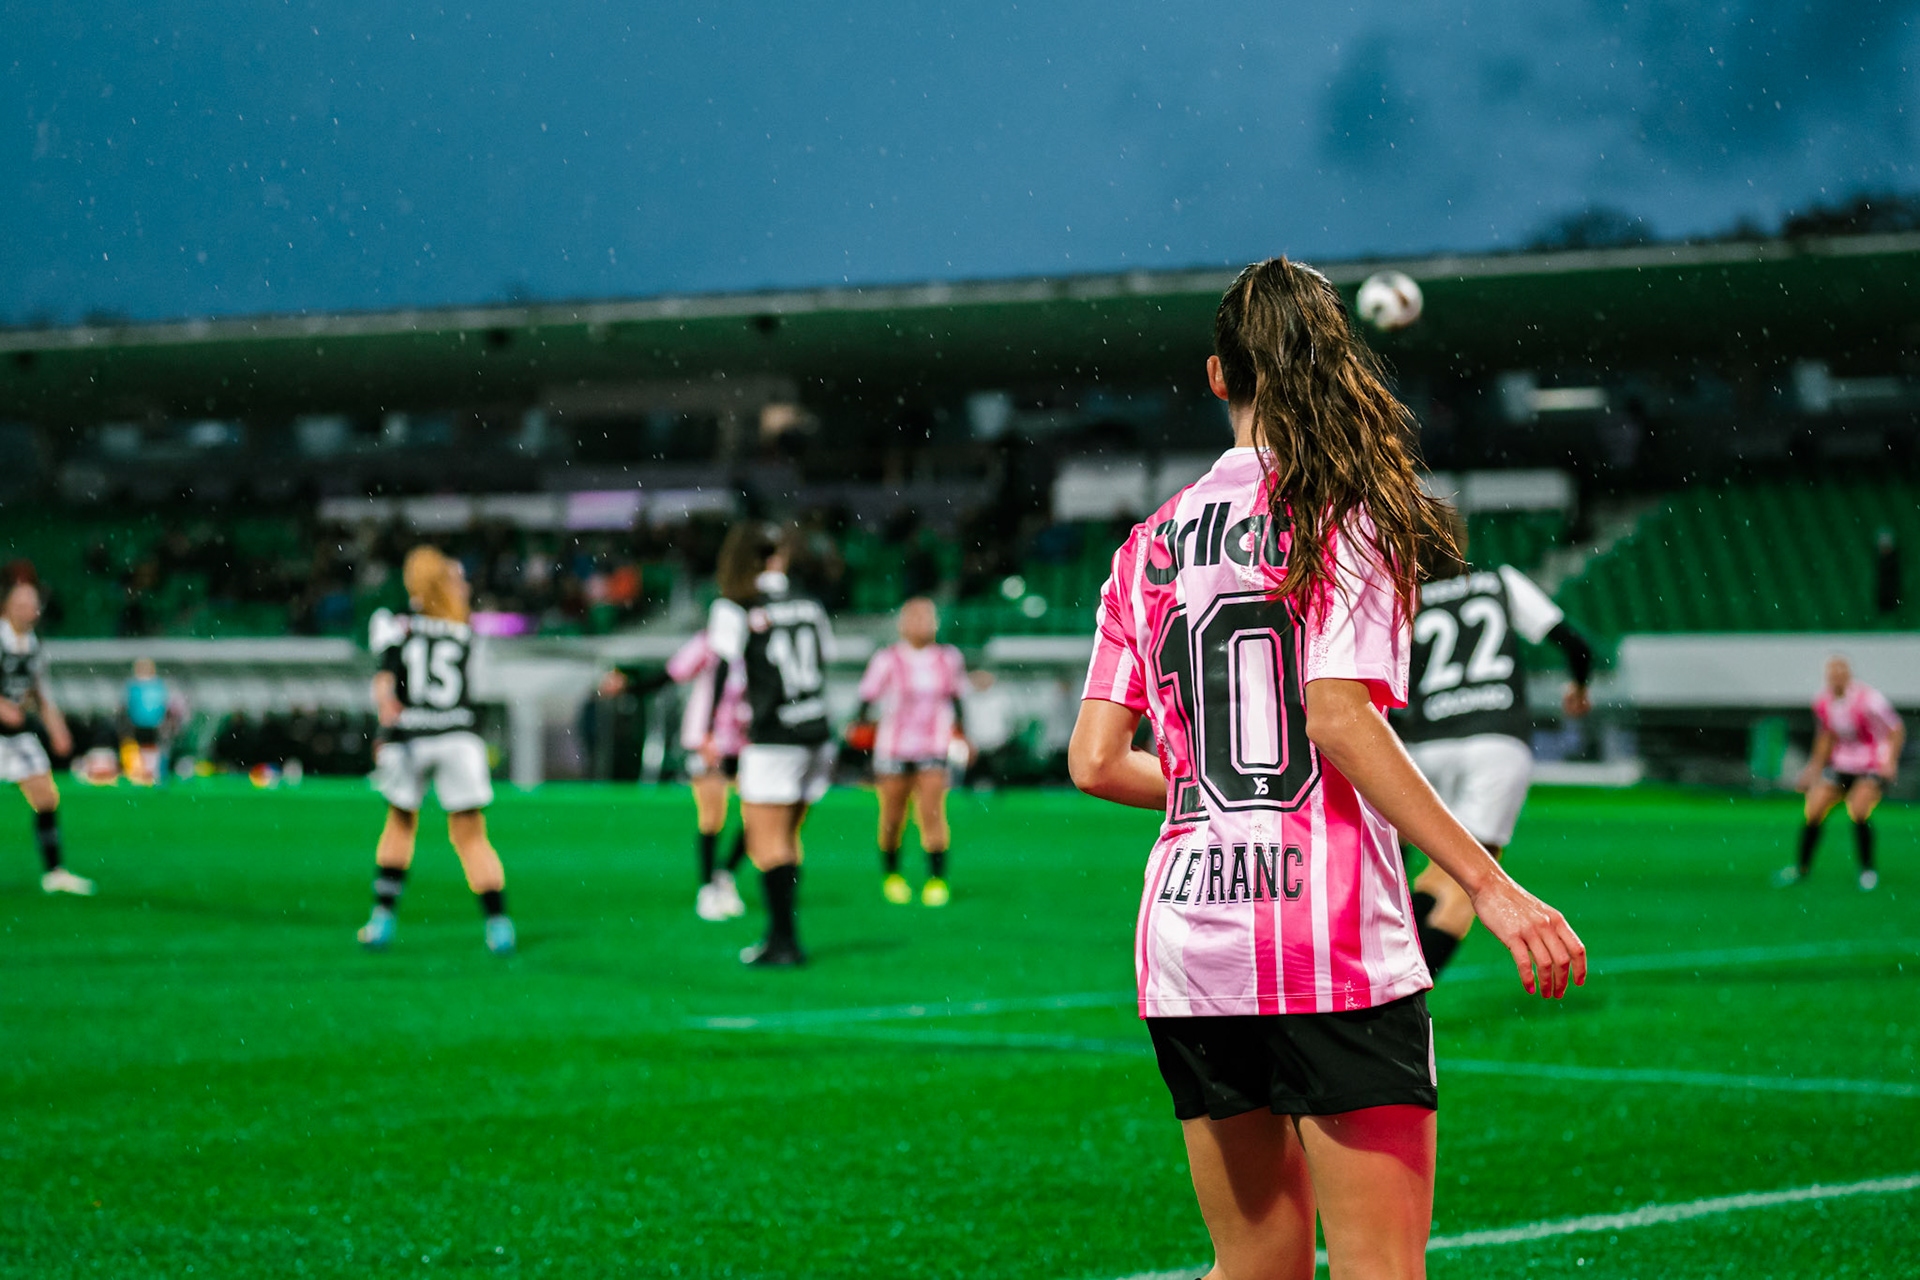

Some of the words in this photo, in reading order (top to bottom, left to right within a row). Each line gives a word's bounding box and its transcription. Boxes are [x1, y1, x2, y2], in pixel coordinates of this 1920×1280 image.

[1145, 501, 1291, 586] Orllat
[401, 635, 464, 710] 15
[1415, 594, 1515, 696] 22
[1152, 590, 1322, 825] 10
[1158, 842, 1304, 906] LERANC
